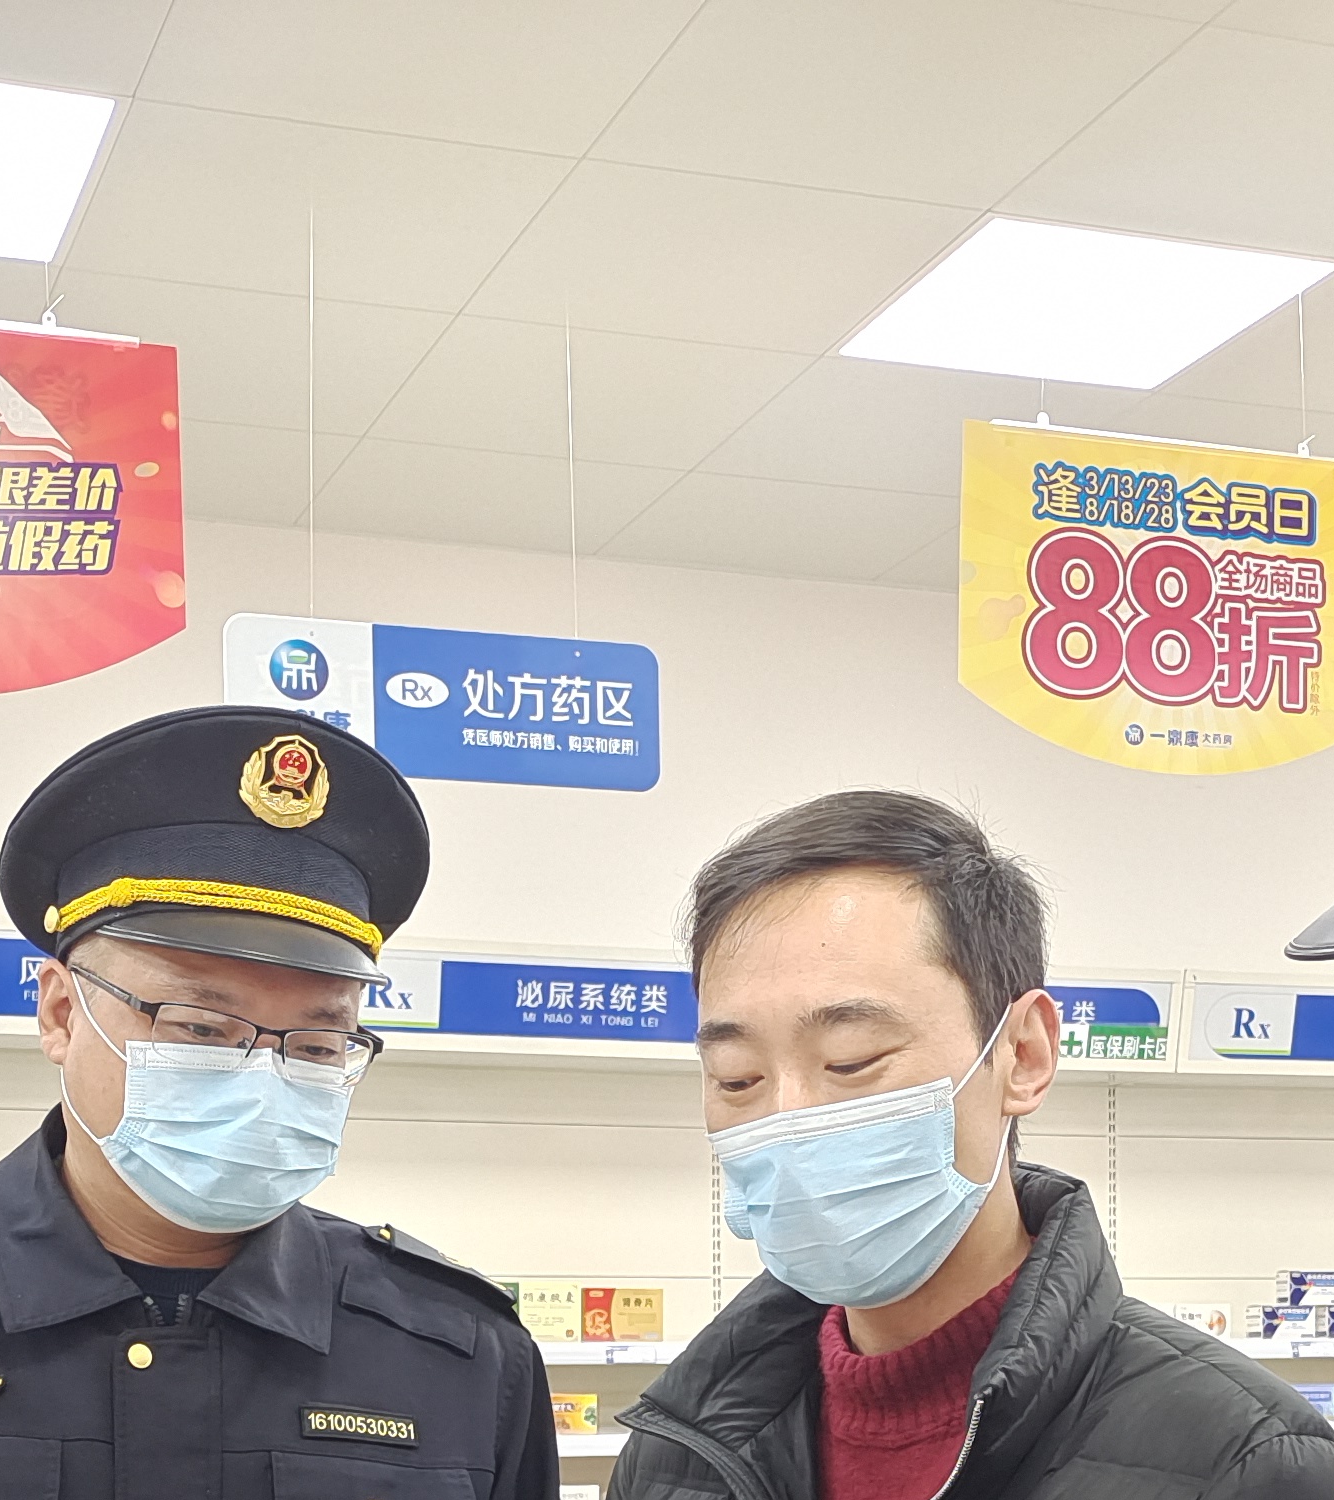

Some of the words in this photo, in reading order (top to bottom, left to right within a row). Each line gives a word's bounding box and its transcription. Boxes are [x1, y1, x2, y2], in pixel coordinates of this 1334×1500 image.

[1035, 466, 1082, 520] 逢
[1084, 470, 1175, 501] 3/13/23
[1183, 480, 1312, 538] 会员日
[1084, 497, 1175, 529] 8/18/28
[1217, 556, 1322, 602] 全场商品
[400, 679, 433, 704] Rx
[462, 668, 634, 728] 处方药区
[515, 978, 668, 1015] 泌尿系统类
[543, 1013, 573, 1025] NIAO
[580, 1015, 593, 1025] XI
[600, 1016, 634, 1027] TONG
[641, 1017, 659, 1028] LEI
[1230, 1006, 1271, 1040] Rx
[307, 1412, 415, 1440] 16100530331
